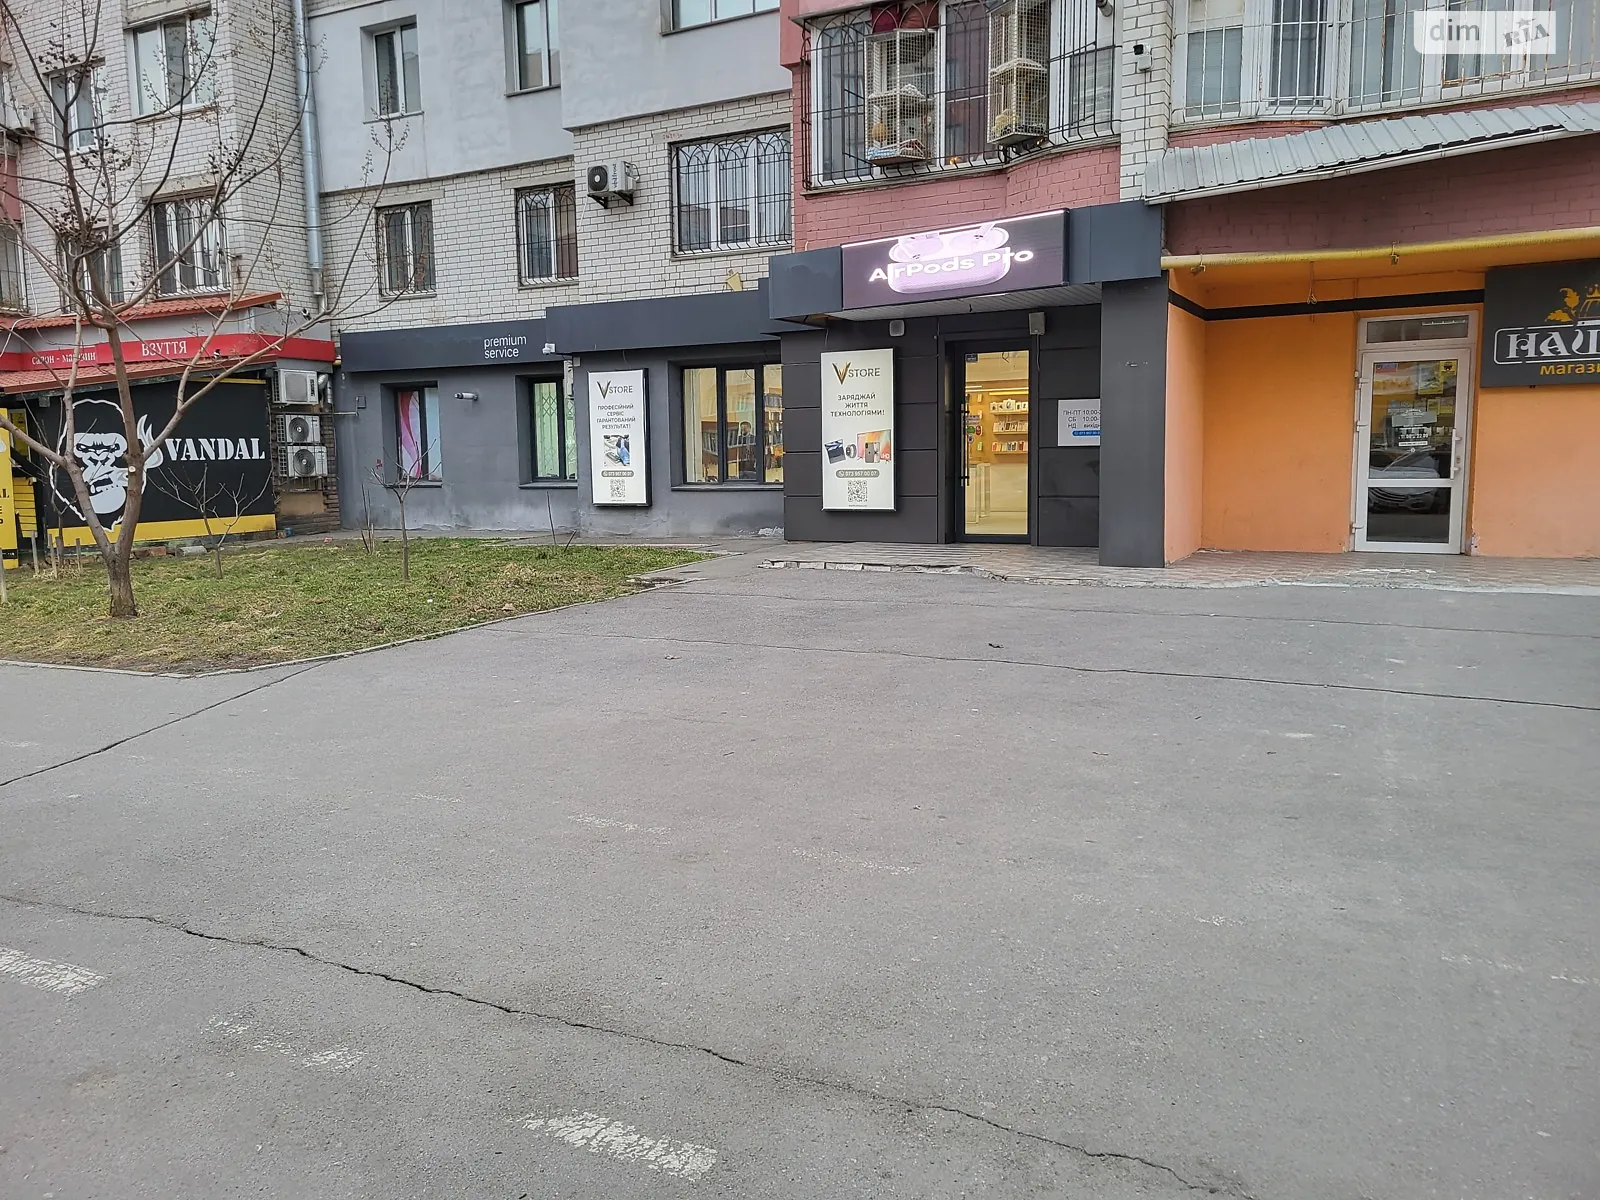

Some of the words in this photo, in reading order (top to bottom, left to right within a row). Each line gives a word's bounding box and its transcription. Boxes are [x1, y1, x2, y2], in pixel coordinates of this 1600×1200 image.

[982, 250, 1034, 267] Pro
[141, 340, 188, 357] ВЗУТТЯ
[484, 334, 527, 350] premium
[484, 346, 519, 359] service
[837, 392, 876, 401] ЗАРЯДЖАЙ
[845, 401, 869, 409] ЖИТТЯ
[830, 409, 885, 417] ТЕХНОЛОГІЯМИ!
[164, 437, 266, 461] VANDAL
